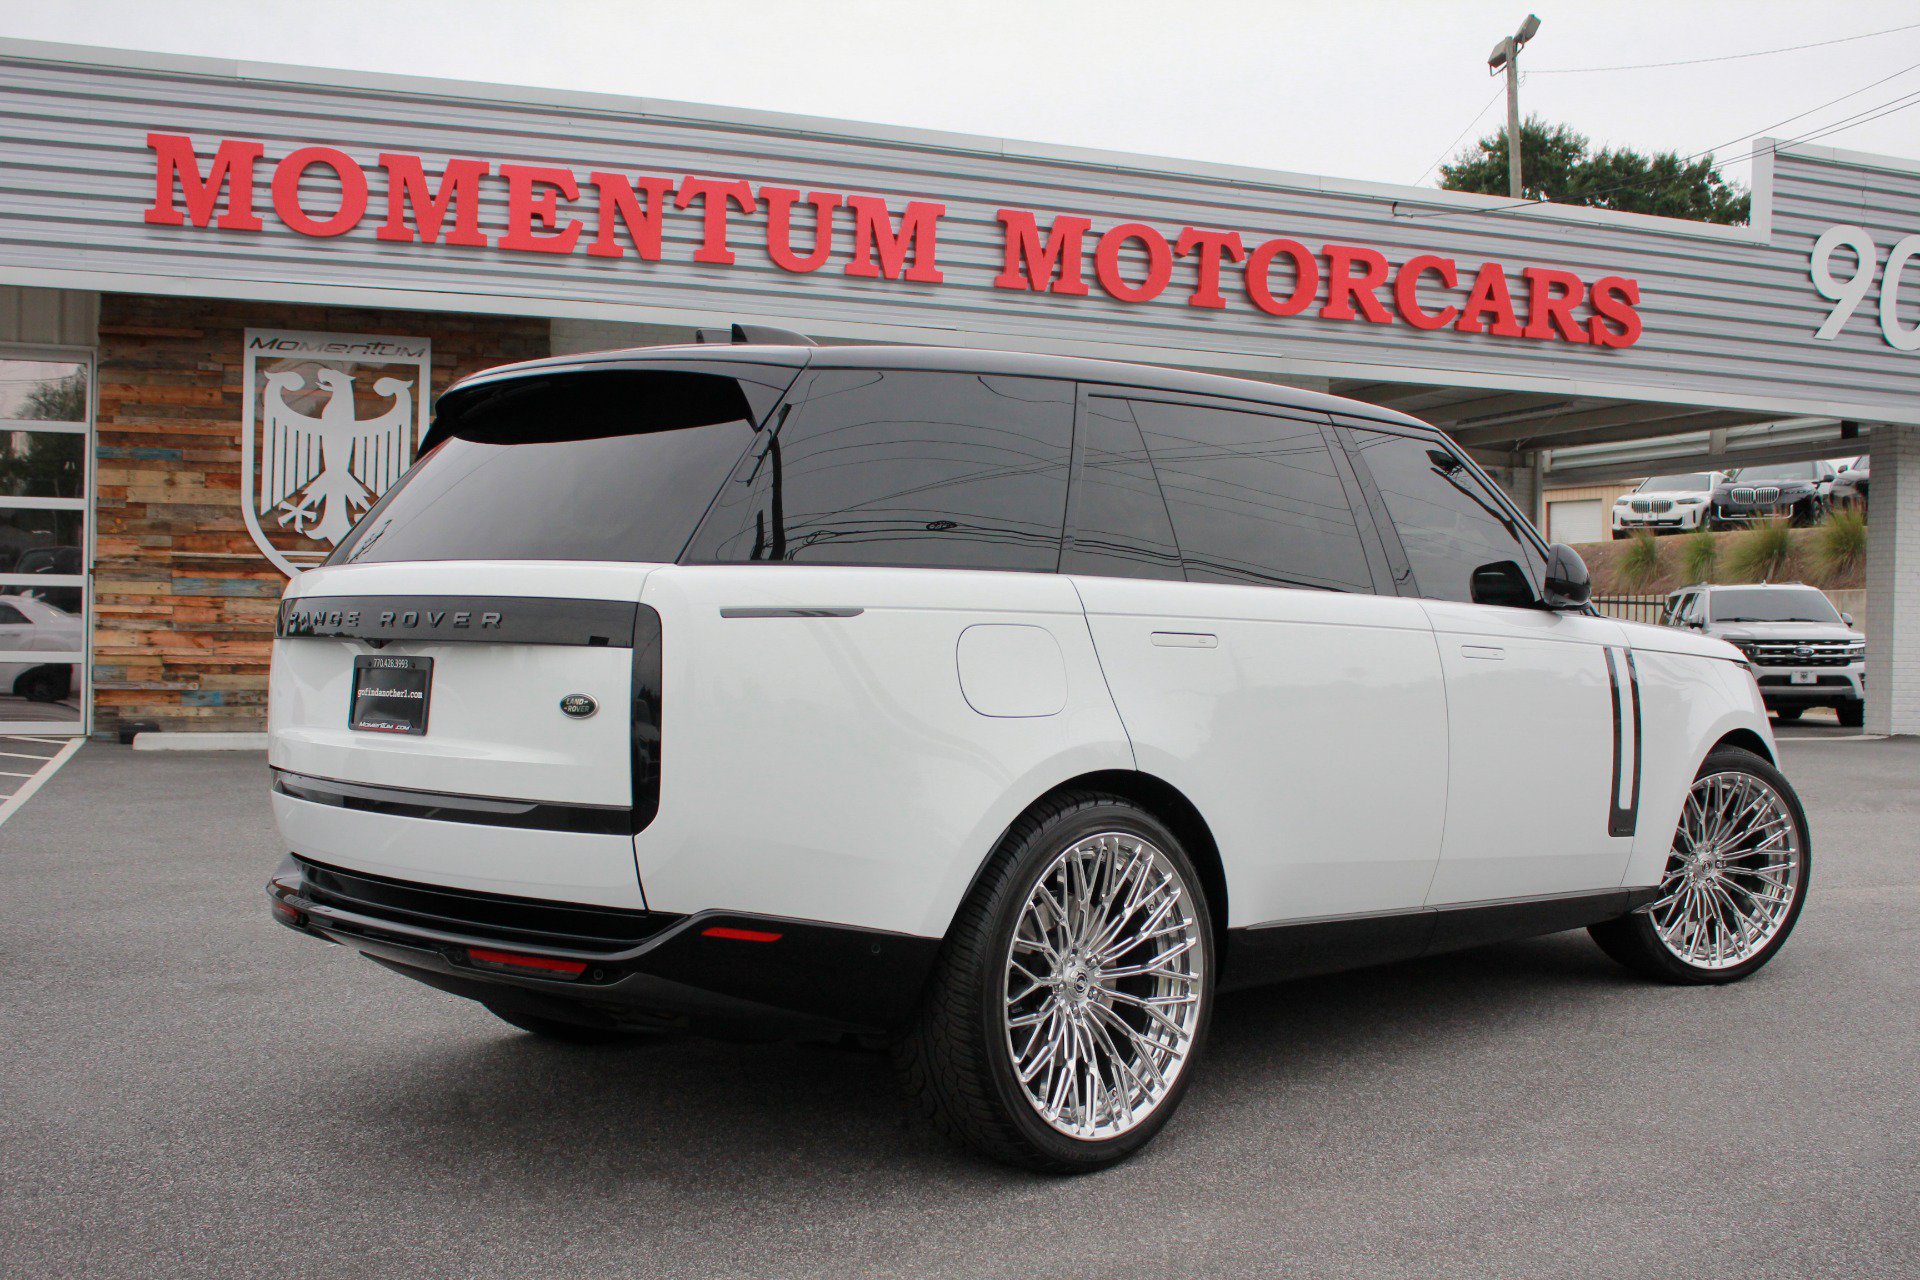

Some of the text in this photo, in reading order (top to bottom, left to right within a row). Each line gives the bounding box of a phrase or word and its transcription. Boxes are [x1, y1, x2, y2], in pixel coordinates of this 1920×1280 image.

[145, 133, 1642, 348] MOMENTUM MOTORCARS
[288, 611, 502, 629] RANGE ROVER
